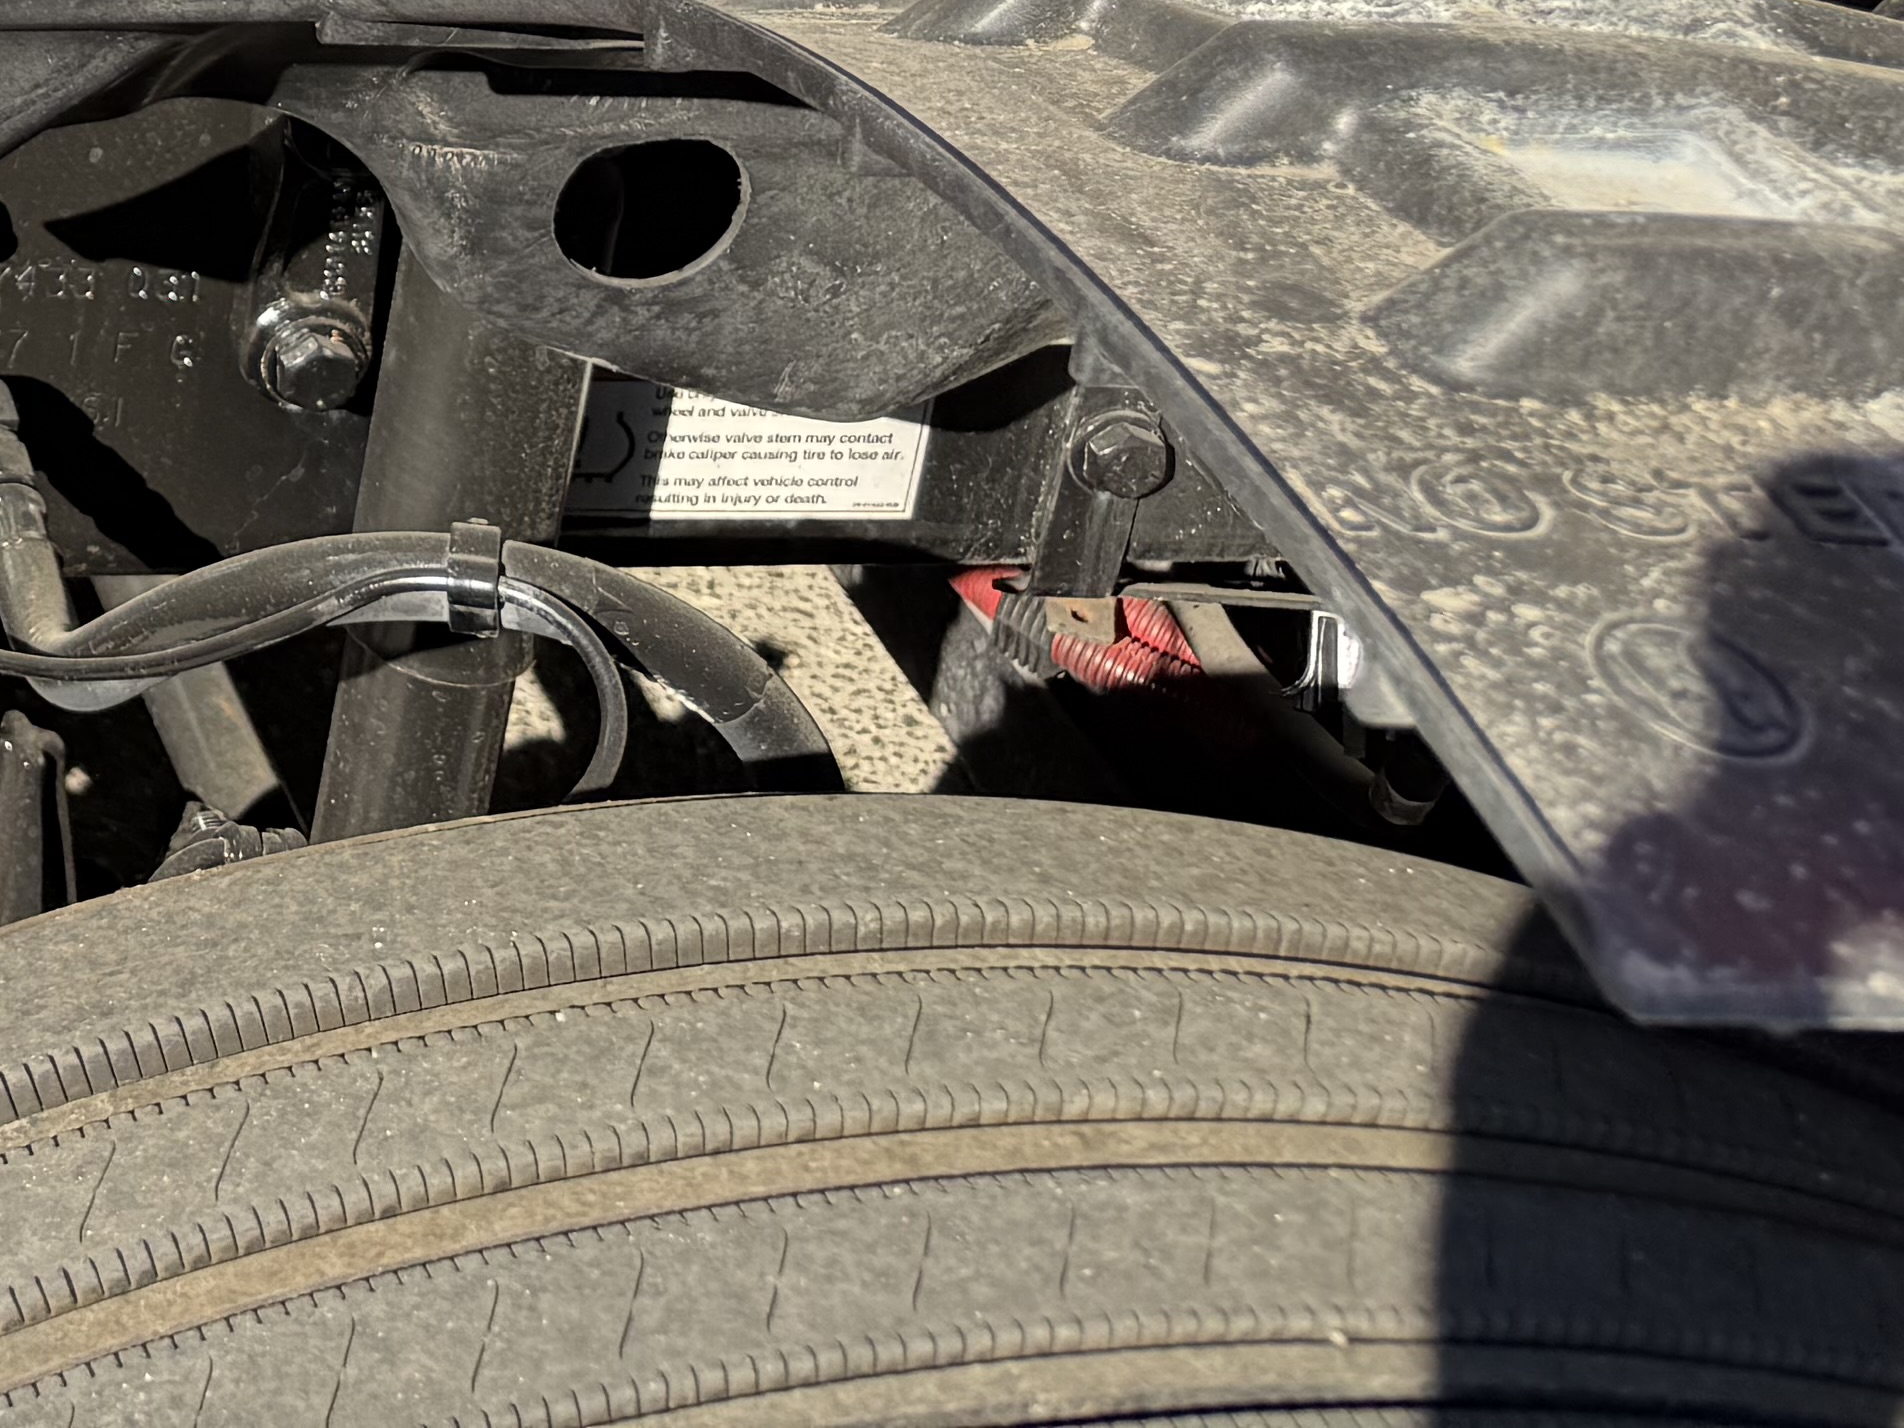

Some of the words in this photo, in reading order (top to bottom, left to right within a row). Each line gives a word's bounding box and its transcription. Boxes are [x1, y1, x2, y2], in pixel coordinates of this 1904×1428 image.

[652, 408, 694, 417] wheel
[698, 407, 726, 417] and
[730, 408, 767, 417] valve
[647, 433, 720, 443] Otherwise
[726, 433, 762, 443] valve
[767, 433, 801, 443] stem
[805, 434, 835, 445] may
[839, 433, 893, 444] contact
[644, 449, 684, 459] brake
[689, 450, 736, 461] caliper
[742, 451, 797, 462] causing
[803, 450, 825, 459] tire
[830, 450, 842, 459] to
[848, 450, 878, 460] lose
[882, 450, 904, 461] air.
[641, 475, 668, 485] This
[674, 476, 702, 488] may
[708, 475, 749, 487] affect
[754, 476, 803, 487] vehicle
[808, 476, 858, 487] control
[635, 494, 698, 506] resulting
[704, 494, 715, 504] in
[721, 494, 761, 506] injury
[766, 495, 780, 505] or
[784, 494, 827, 505] death.
